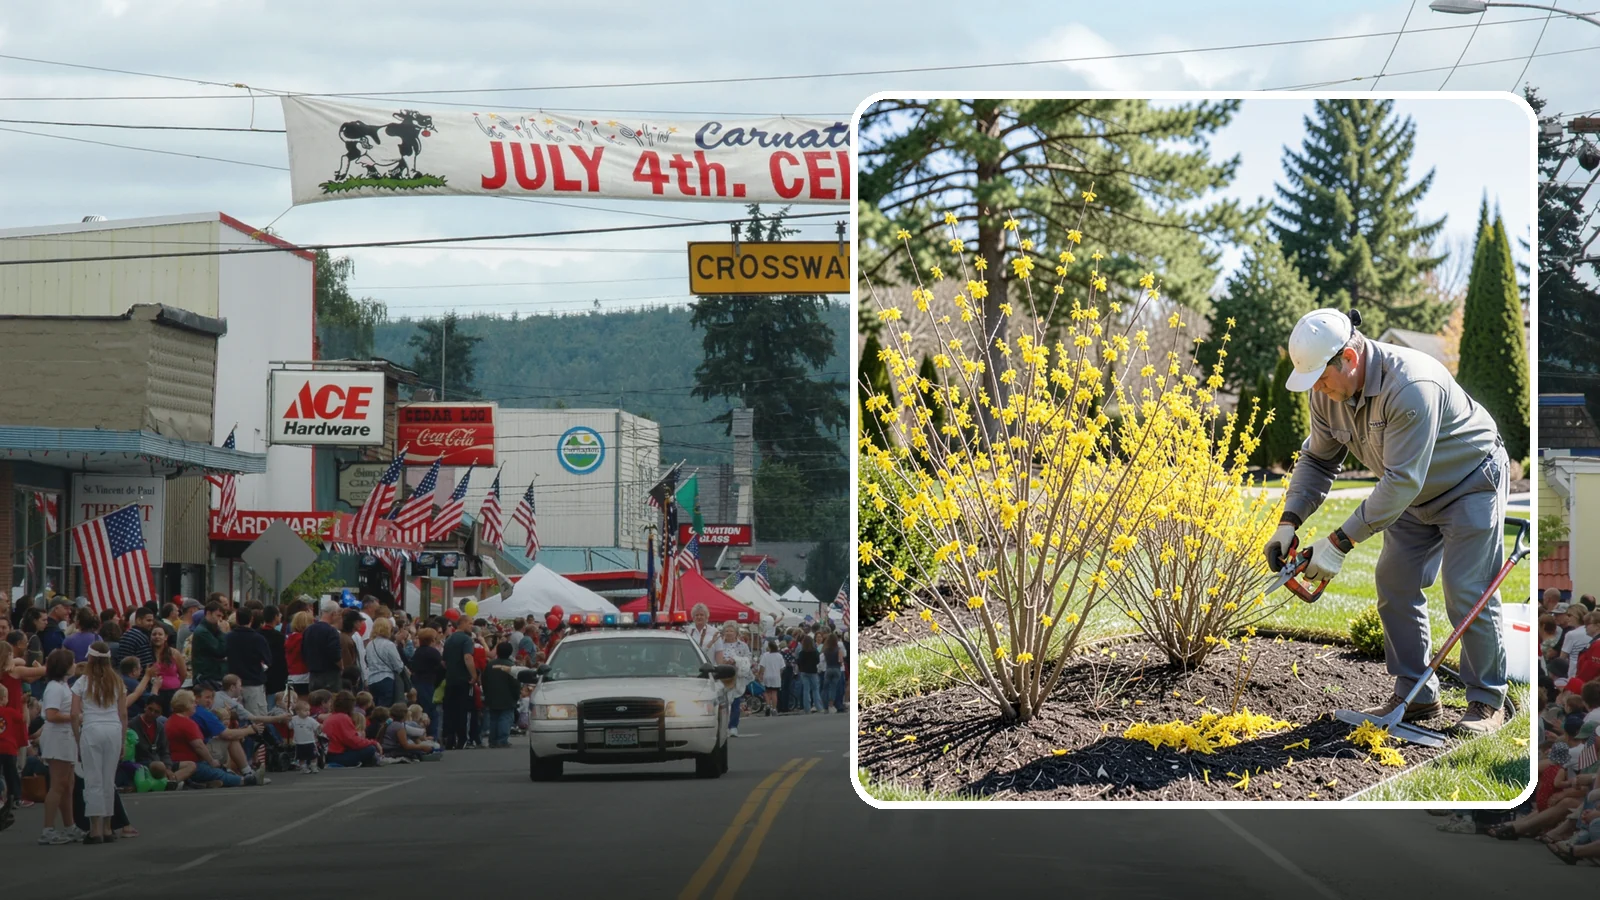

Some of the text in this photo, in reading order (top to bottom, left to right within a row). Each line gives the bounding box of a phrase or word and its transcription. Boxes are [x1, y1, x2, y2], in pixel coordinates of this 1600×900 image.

[481, 141, 605, 192] JULY
[632, 150, 746, 198] 4th.
[697, 254, 850, 280] CROSSWA
[283, 380, 373, 420] ACE
[405, 409, 453, 422] CEDAR
[283, 421, 371, 437] Hardware
[416, 428, 477, 447] Coca-Cola
[95, 484, 125, 495] Vincent
[126, 486, 136, 495] de
[137, 486, 155, 495] Paul
[688, 526, 741, 535] CRNATION
[699, 535, 730, 543] GLASS
